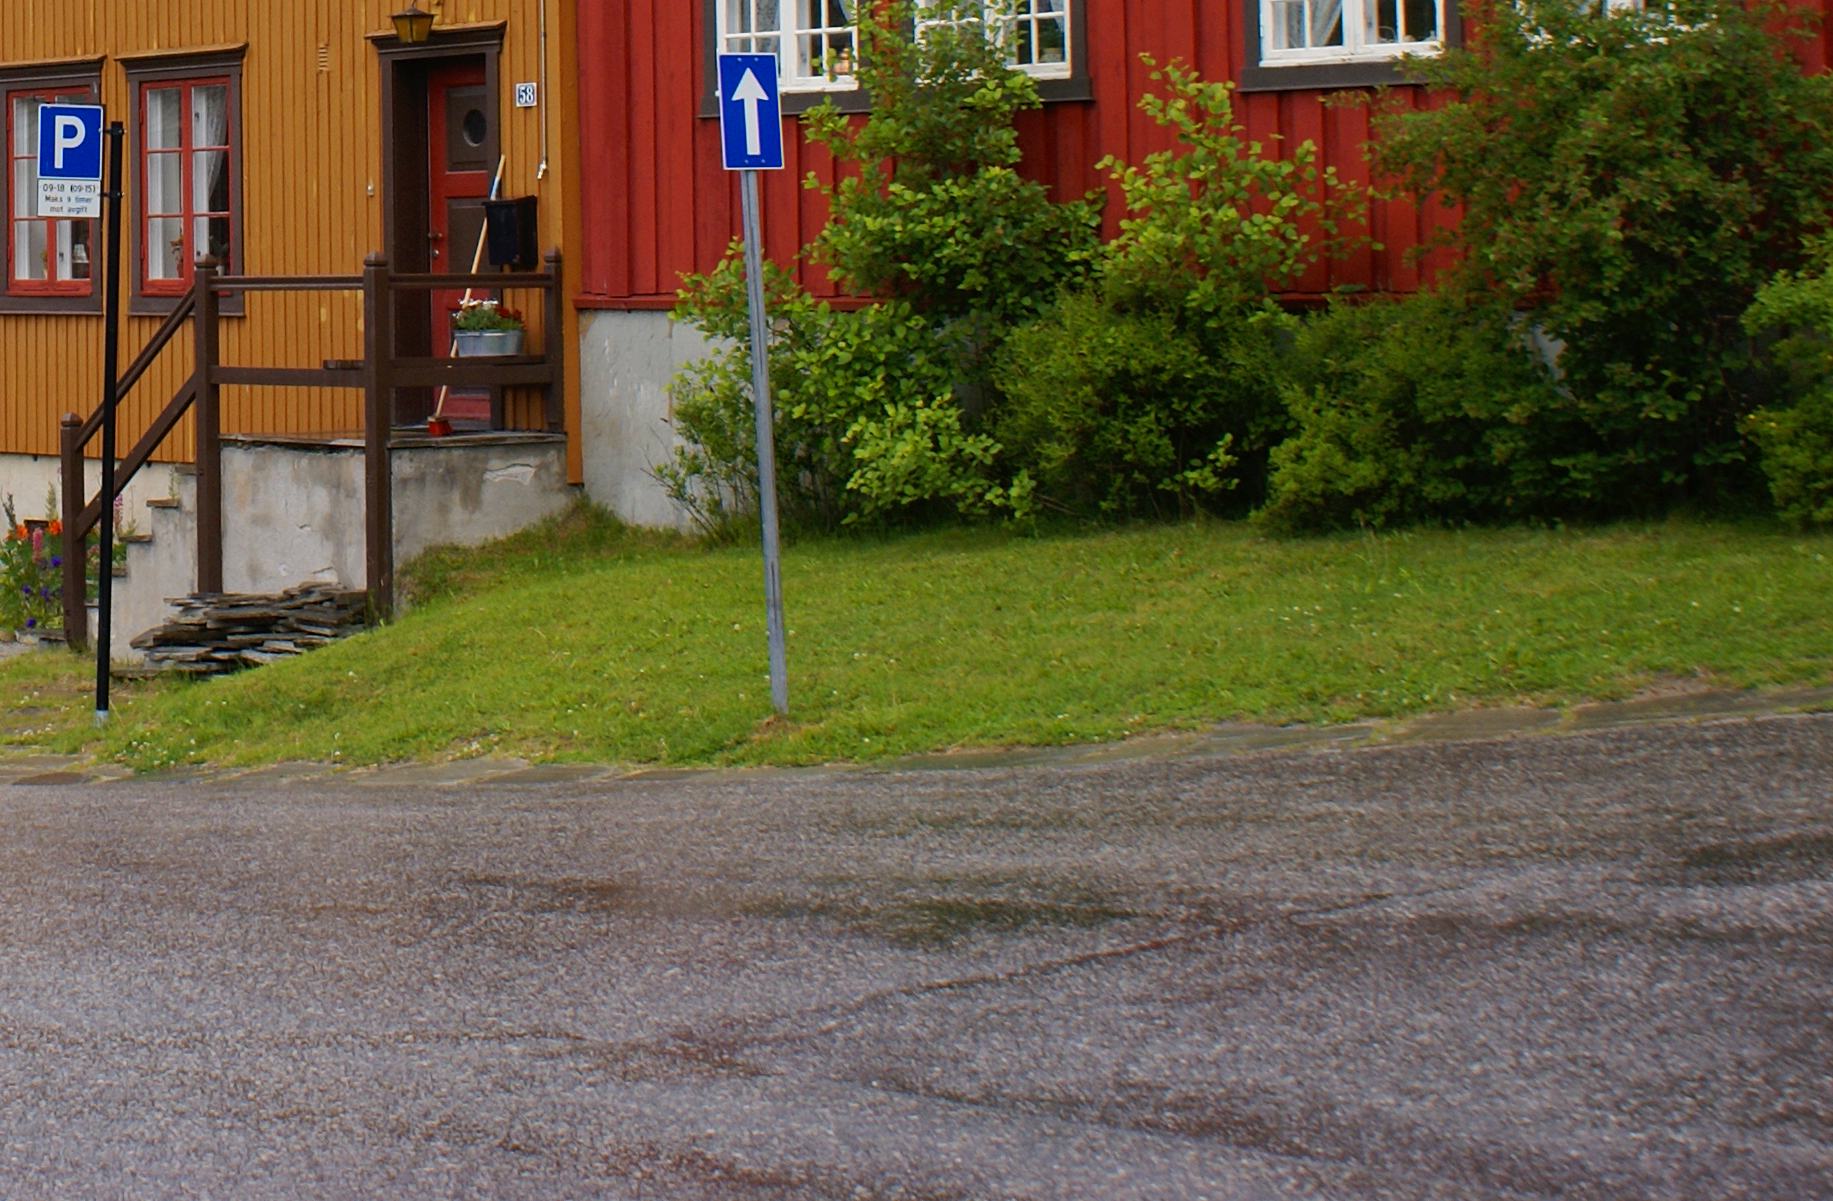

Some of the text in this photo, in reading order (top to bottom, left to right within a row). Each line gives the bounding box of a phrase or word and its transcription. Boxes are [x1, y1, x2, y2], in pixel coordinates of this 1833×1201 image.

[519, 86, 534, 104] 58
[54, 115, 86, 169] P
[42, 183, 65, 193] 09-18
[67, 206, 88, 215] avgift
